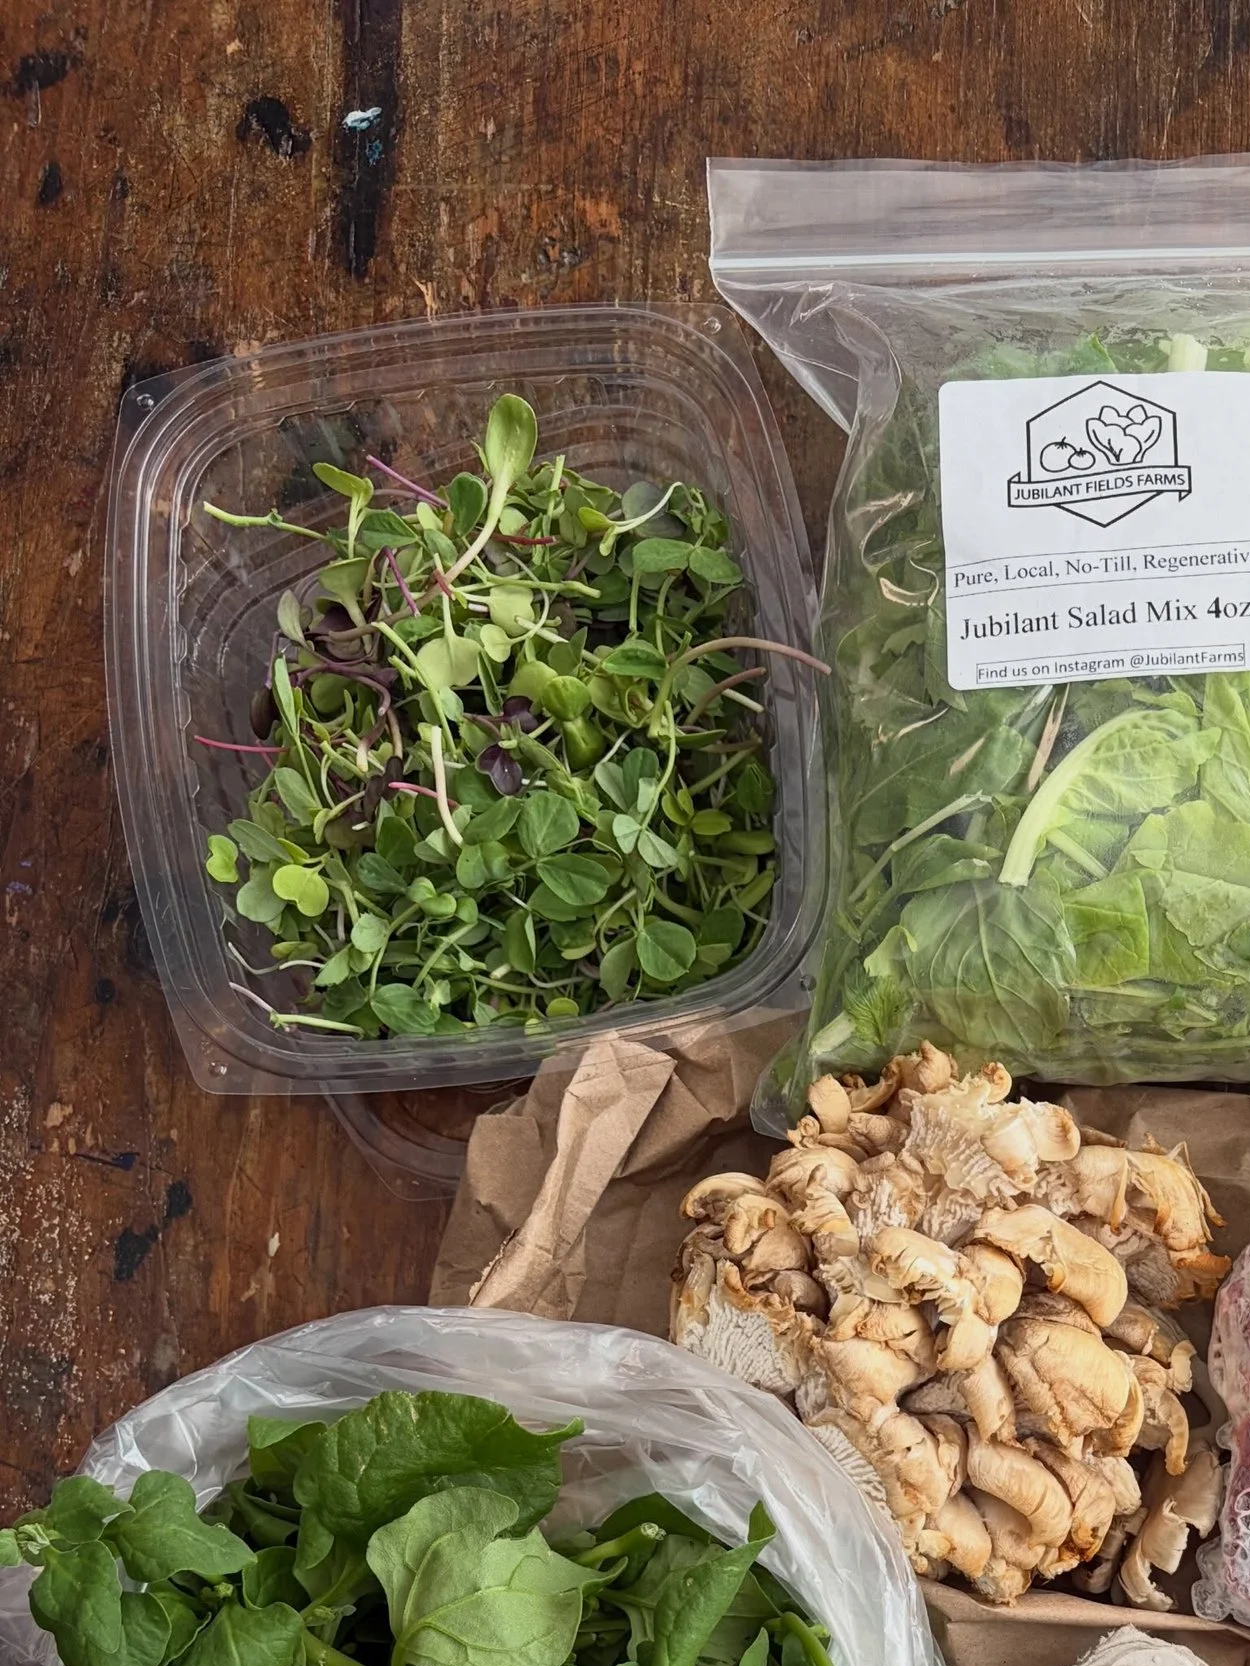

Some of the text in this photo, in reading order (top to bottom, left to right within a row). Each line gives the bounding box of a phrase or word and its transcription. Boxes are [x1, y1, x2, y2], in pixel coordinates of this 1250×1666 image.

[1014, 473, 1186, 500] JUBILANT FIELDS FARMS
[953, 571, 998, 588] Pure,
[1004, 561, 1059, 581] Local,
[1066, 555, 1137, 576] No-Till,
[960, 611, 1059, 641] Jubilant
[1067, 602, 1137, 630] Salad
[1145, 598, 1199, 623] Mix
[977, 648, 1244, 680] Find us on Instagram @JubilantFarms
